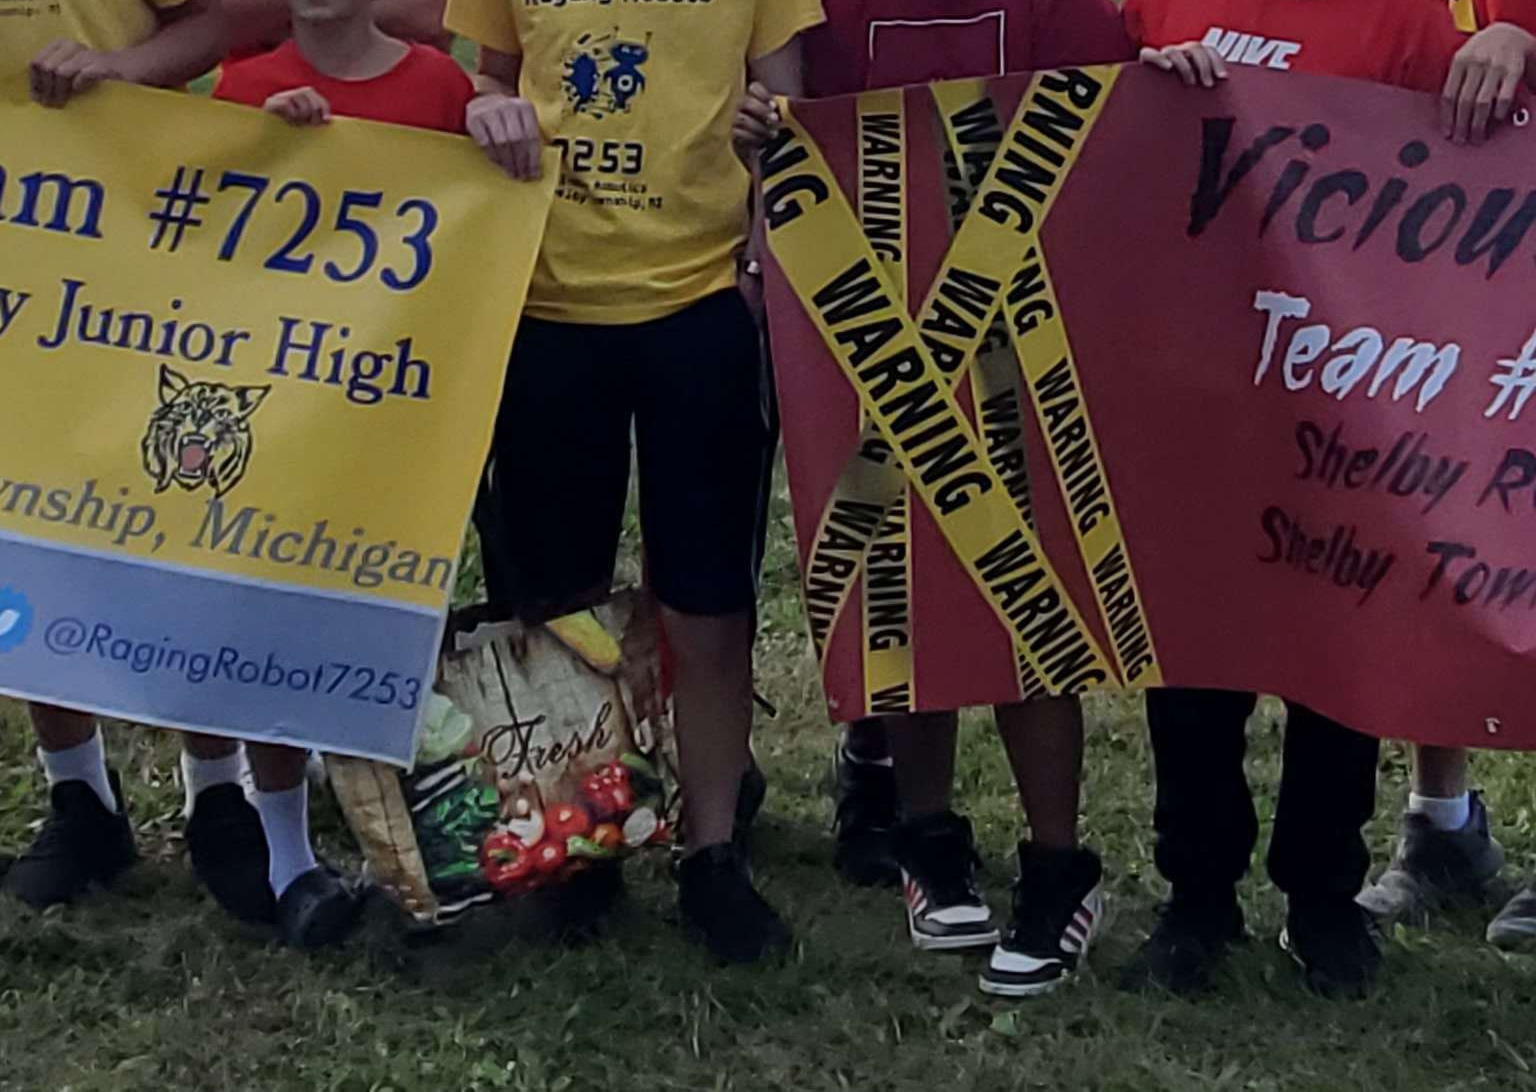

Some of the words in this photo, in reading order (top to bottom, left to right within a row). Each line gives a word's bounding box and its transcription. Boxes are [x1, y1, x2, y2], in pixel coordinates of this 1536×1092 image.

[976, 69, 1103, 234] RNING
[146, 164, 439, 293] #7253
[37, 277, 250, 367] Junior
[266, 314, 432, 406] High
[812, 257, 994, 516] WARNING
[1253, 289, 1463, 412] Team
[1034, 357, 1111, 536] WARNING
[1294, 420, 1468, 515] Shelby
[189, 496, 453, 590] Michigan
[1258, 505, 1397, 609] Shelby
[43, 616, 422, 710] @RagingRobot7253
[1092, 542, 1155, 683] WARNING
[481, 701, 613, 778] Fresh
